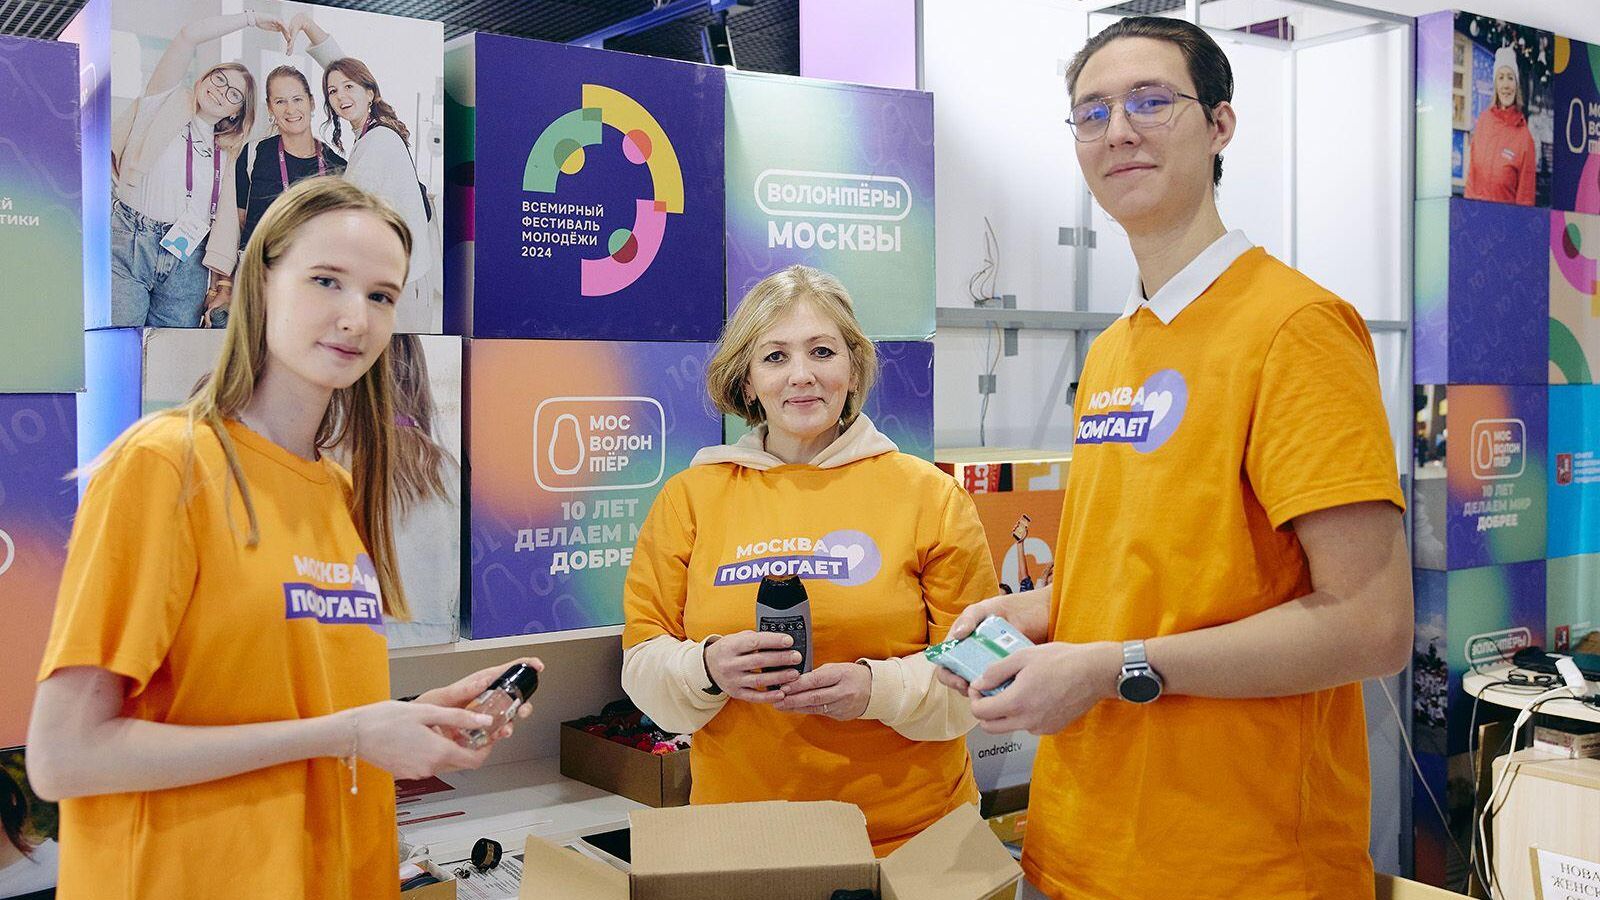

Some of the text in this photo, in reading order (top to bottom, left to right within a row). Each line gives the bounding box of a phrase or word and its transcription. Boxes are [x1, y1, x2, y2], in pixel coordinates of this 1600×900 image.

[0, 197, 12, 210] Й
[767, 181, 901, 210] ВОЛОНТЁРЫ
[521, 201, 605, 218] ВСЕМИРНЫЙ
[521, 216, 601, 232] ФЕСТИВАЛЬ
[521, 230, 598, 248] МОЛОДЁЖИ
[768, 222, 902, 252] МОСКВЫ
[521, 246, 552, 259] 2024
[589, 415, 631, 431] МОС
[1077, 416, 1149, 440] ОМГАЕТ
[589, 435, 652, 451] ВОЛОН
[1494, 430, 1512, 441] МОС
[1494, 443, 1521, 453] ВОЛОН
[589, 452, 629, 472] ТЁР
[1482, 484, 1514, 497] 10 ЛЕТ
[561, 498, 639, 520] 10 ЛЕТ
[1463, 498, 1532, 517] ДЕЛАЕМ МИР
[1477, 514, 1518, 532] ДОБРЕЕ
[514, 525, 621, 553] ДЕЛАЕМ
[736, 537, 829, 559] МОСКВА
[293, 554, 364, 585] МОКВА
[720, 560, 843, 582] ПОМОГАЕТ
[290, 589, 377, 618] ПООГАЕТ
